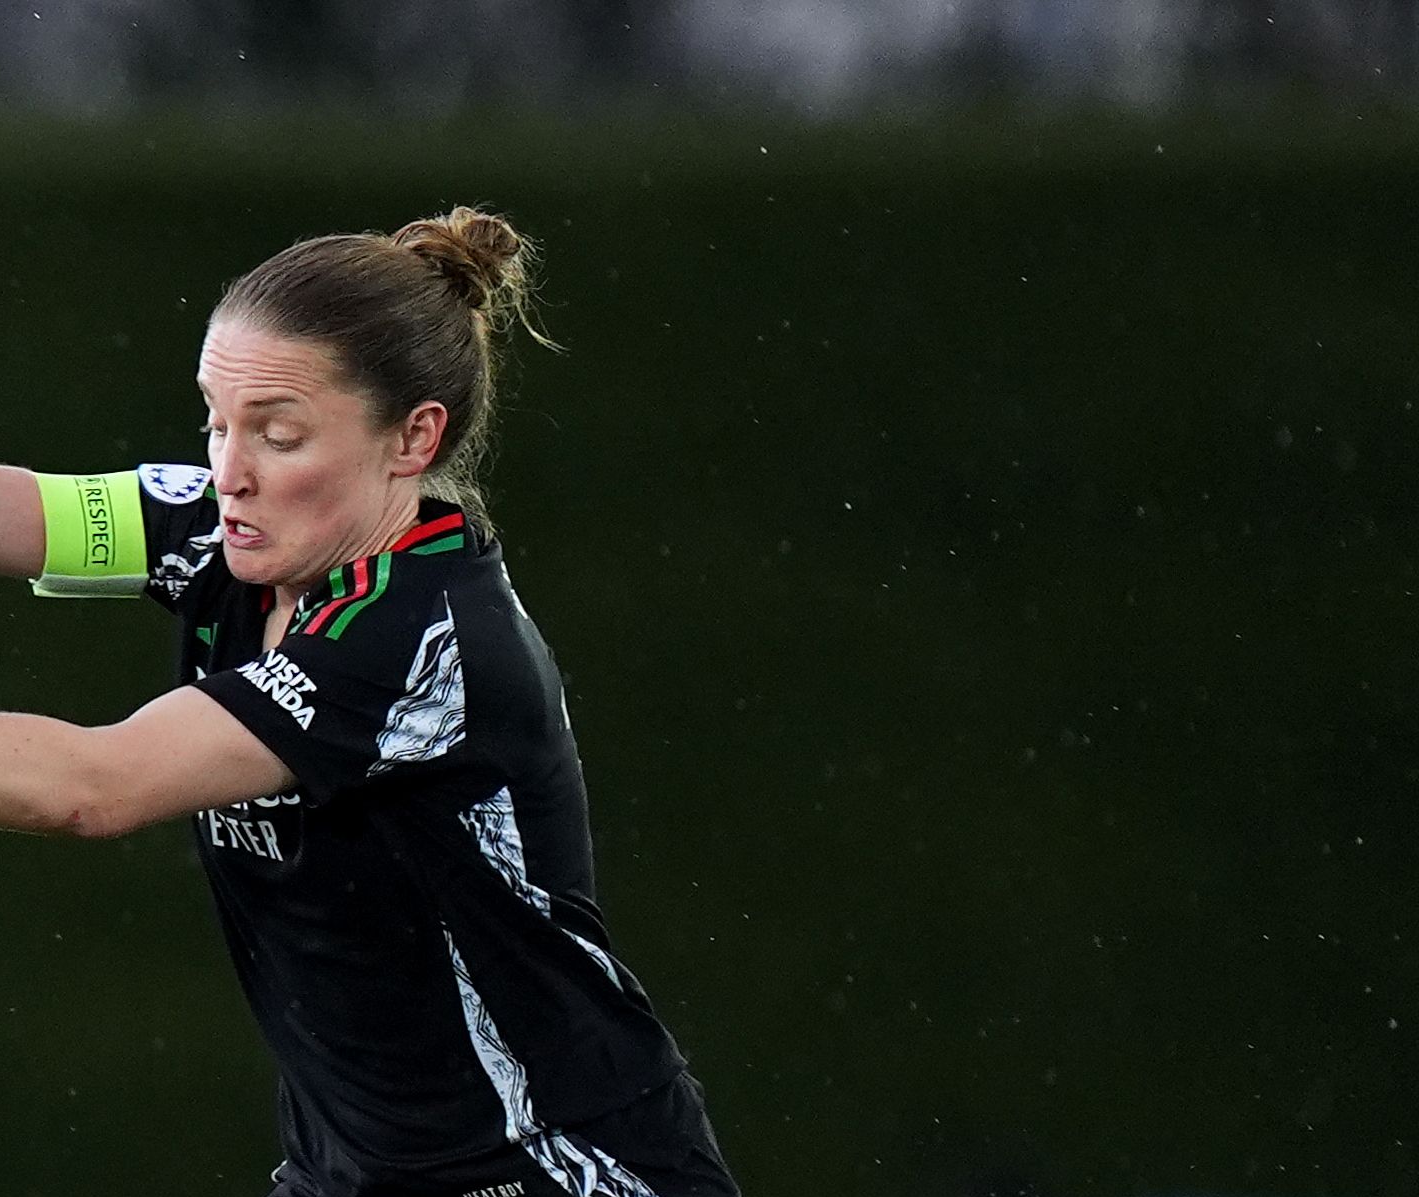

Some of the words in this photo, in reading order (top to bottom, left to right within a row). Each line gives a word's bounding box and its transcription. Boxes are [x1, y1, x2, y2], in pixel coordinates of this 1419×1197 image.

[84, 488, 109, 567] RESPECT
[264, 648, 317, 693] VISIT
[198, 808, 284, 862] ETTER
